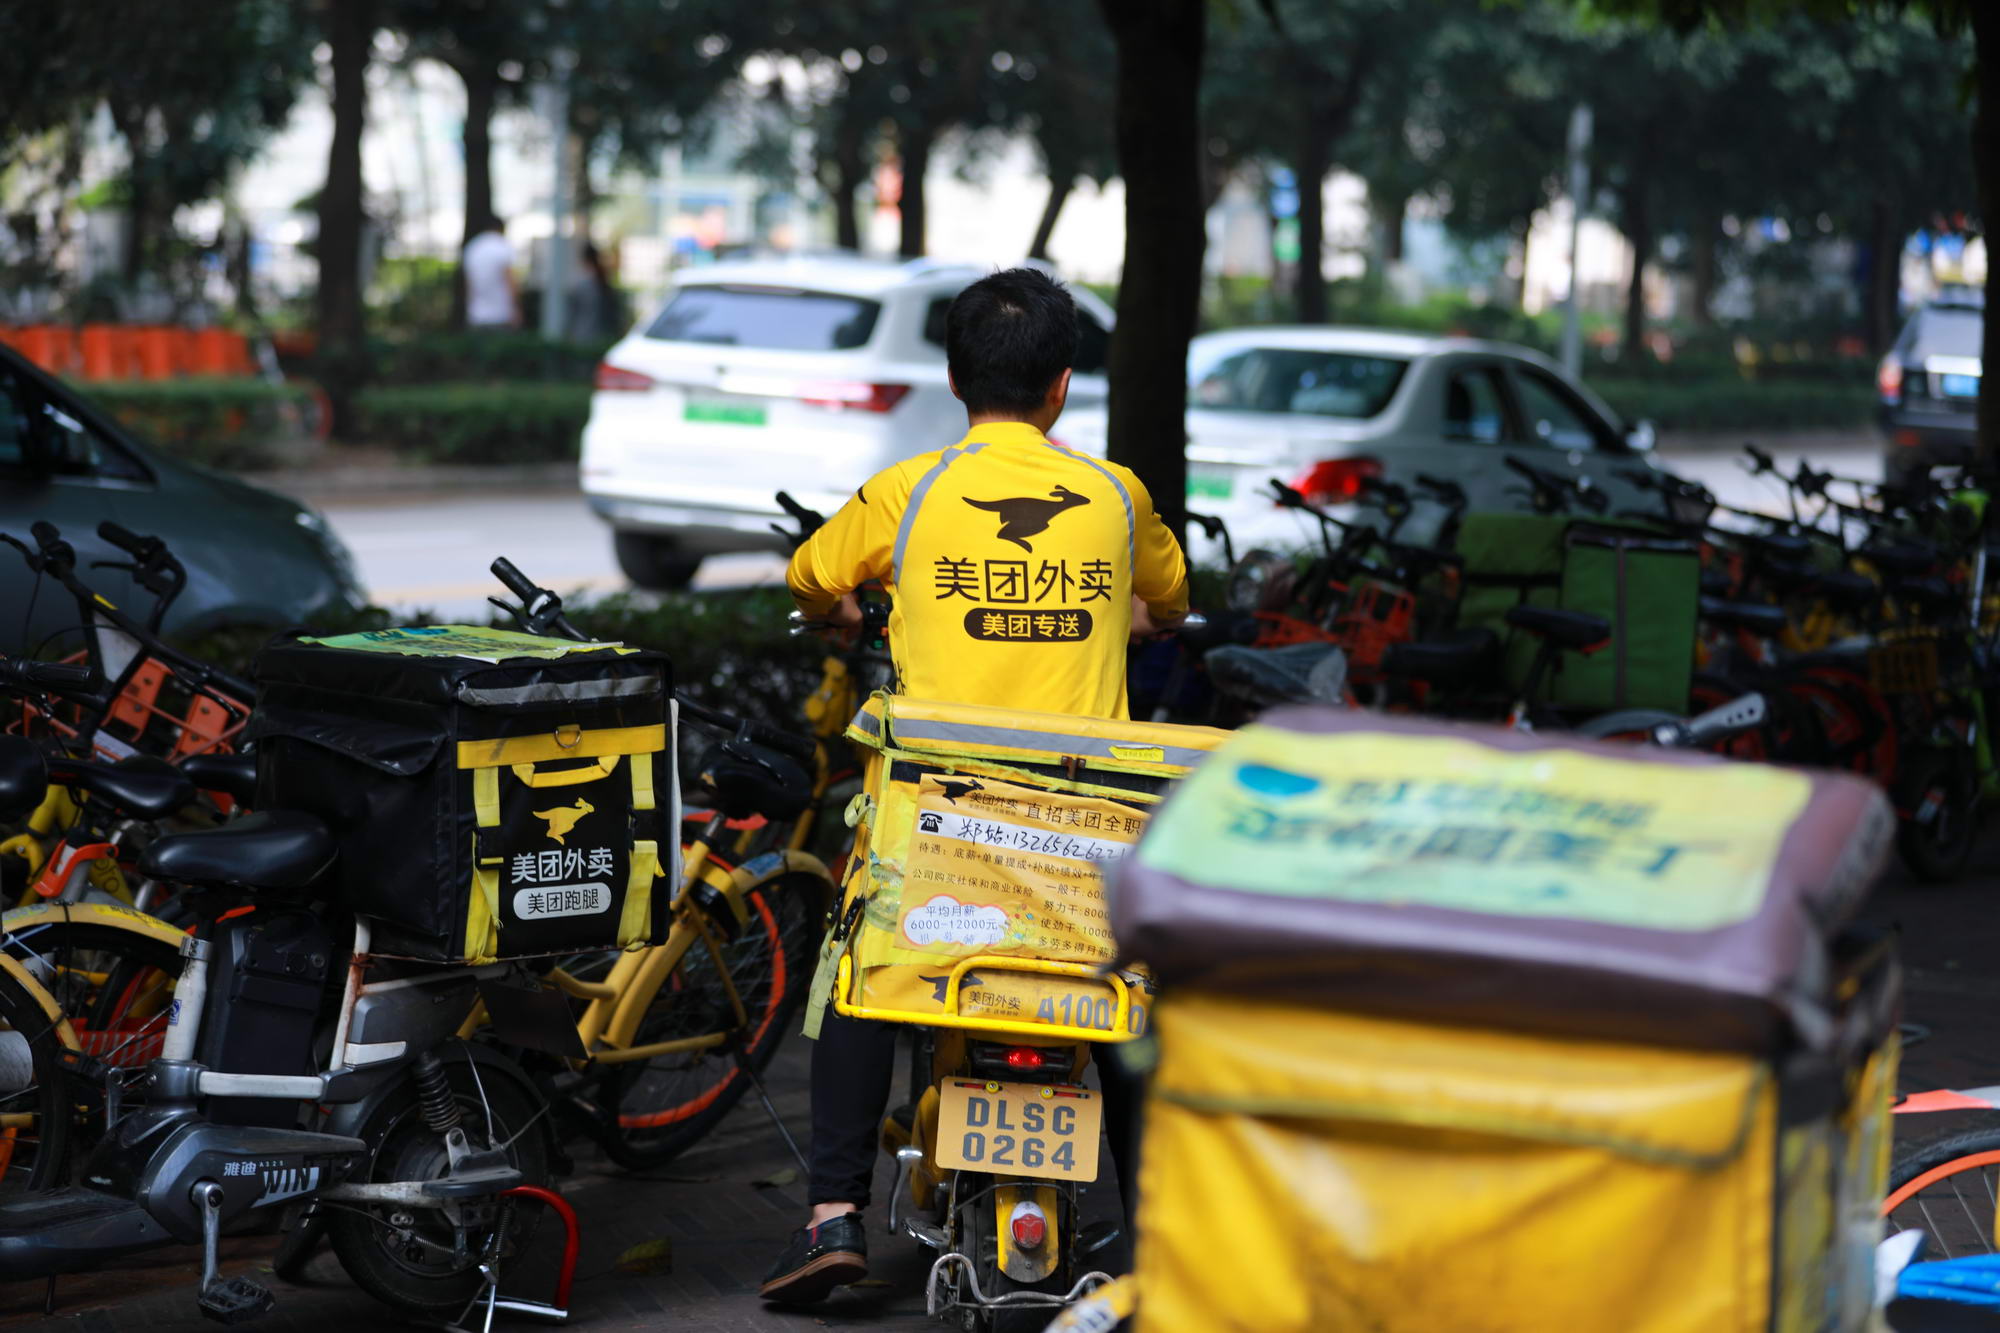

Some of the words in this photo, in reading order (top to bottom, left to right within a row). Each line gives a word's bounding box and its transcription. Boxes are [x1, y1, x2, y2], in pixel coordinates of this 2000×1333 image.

[934, 556, 1112, 604] 美团外卖
[982, 613, 1080, 638] 美团专送
[969, 791, 1018, 810] 美团外卖
[511, 846, 614, 884] 美团外卖
[528, 888, 600, 914] 美团跑腿
[925, 904, 976, 918] 平均月薪
[968, 991, 1022, 1011] 美团外卖
[1037, 993, 1146, 1034] A1000
[966, 1096, 1076, 1136] DLSC
[962, 1131, 1076, 1172] 0264
[223, 1161, 257, 1176] 雅迪
